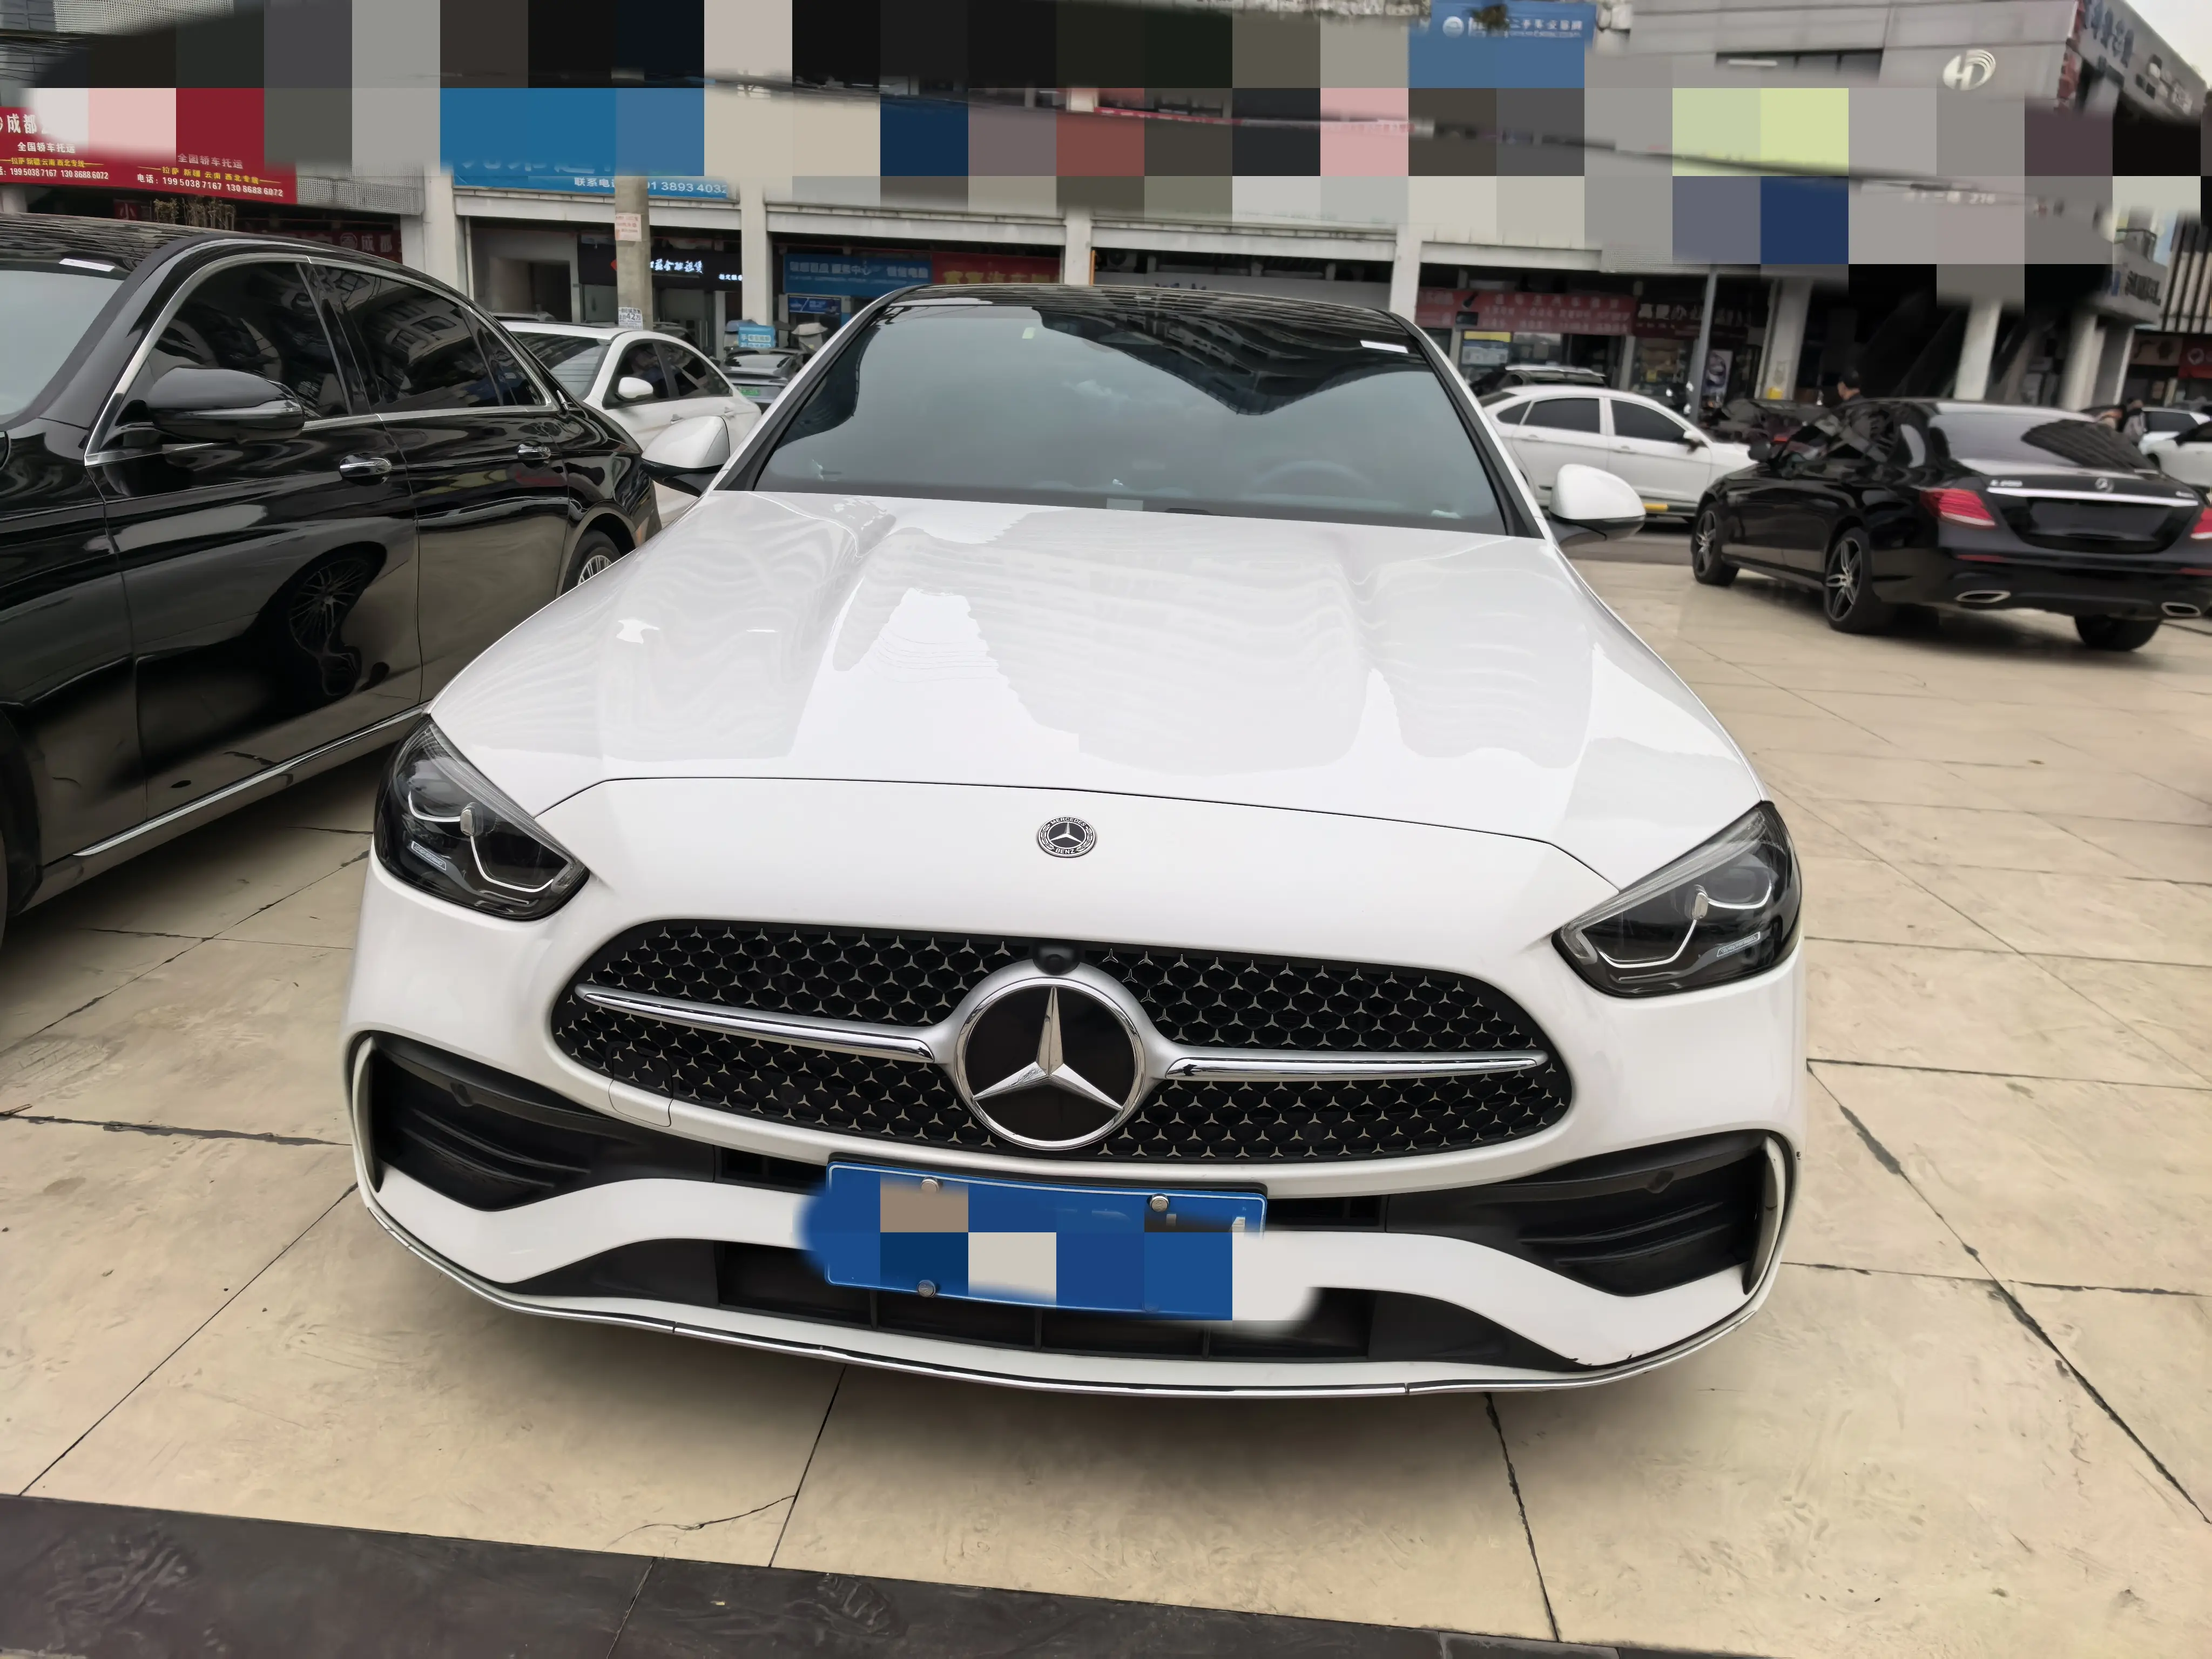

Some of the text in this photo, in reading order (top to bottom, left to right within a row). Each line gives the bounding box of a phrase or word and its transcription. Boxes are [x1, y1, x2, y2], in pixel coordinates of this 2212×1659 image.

[17, 141, 76, 154] 全国轿车托运
[177, 153, 244, 169] 全国轿车托运
[661, 182, 694, 191] 3893
[1050, 817, 1087, 826] MERCEDES
